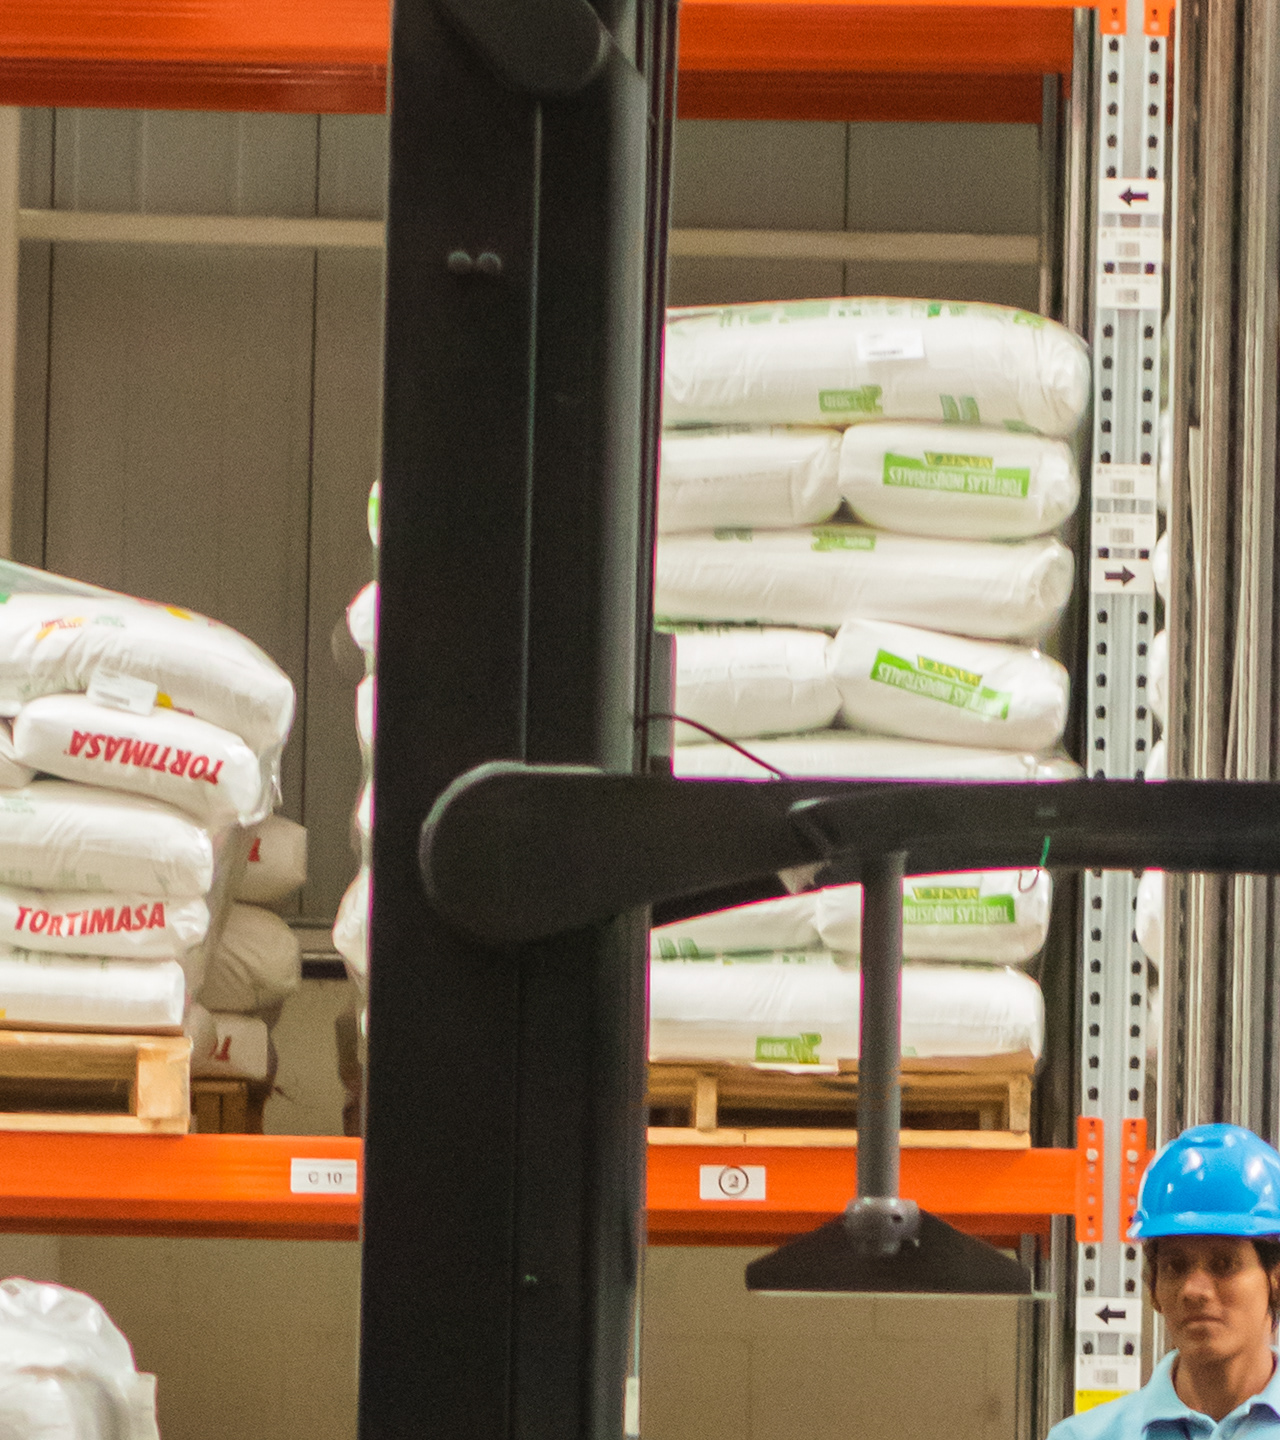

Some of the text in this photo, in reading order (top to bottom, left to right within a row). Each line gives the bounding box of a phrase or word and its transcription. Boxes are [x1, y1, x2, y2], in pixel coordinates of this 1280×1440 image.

[67, 729, 225, 786] TORTIMASA
[13, 901, 167, 937] TORTIMASA
[326, 1171, 343, 1185] 10
